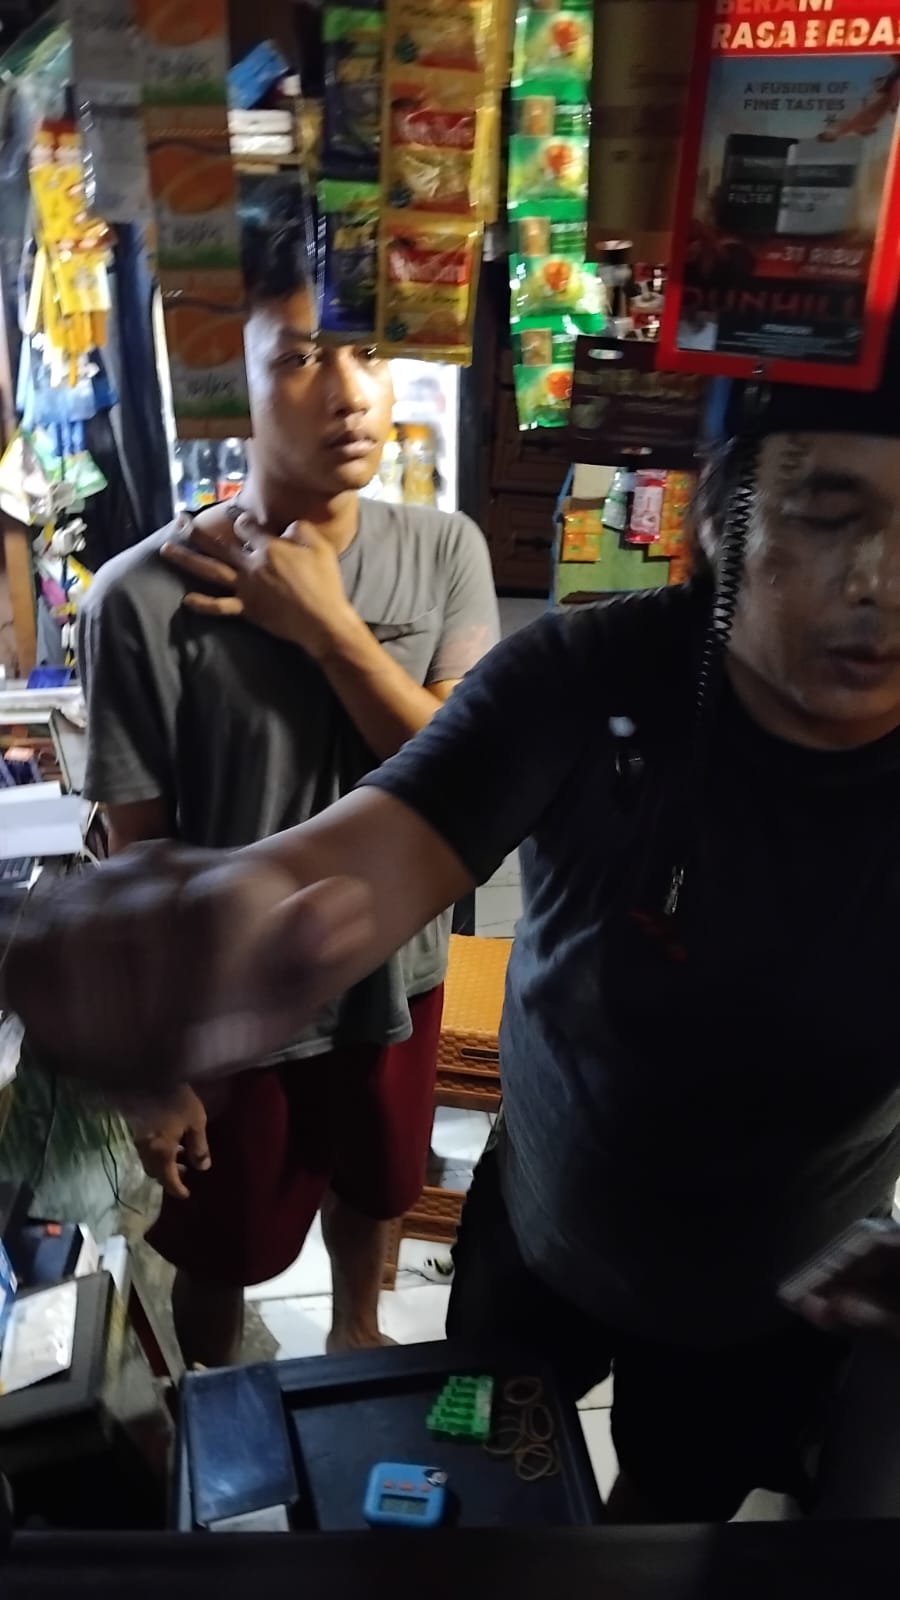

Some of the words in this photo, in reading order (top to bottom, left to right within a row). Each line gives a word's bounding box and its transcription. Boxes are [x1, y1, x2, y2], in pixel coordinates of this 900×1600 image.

[712, 20, 796, 49] RASA
[743, 82, 754, 94] A
[760, 81, 821, 94] FUSION
[826, 81, 849, 94] OF
[743, 98, 780, 111] FINE
[785, 98, 846, 112] TASTES
